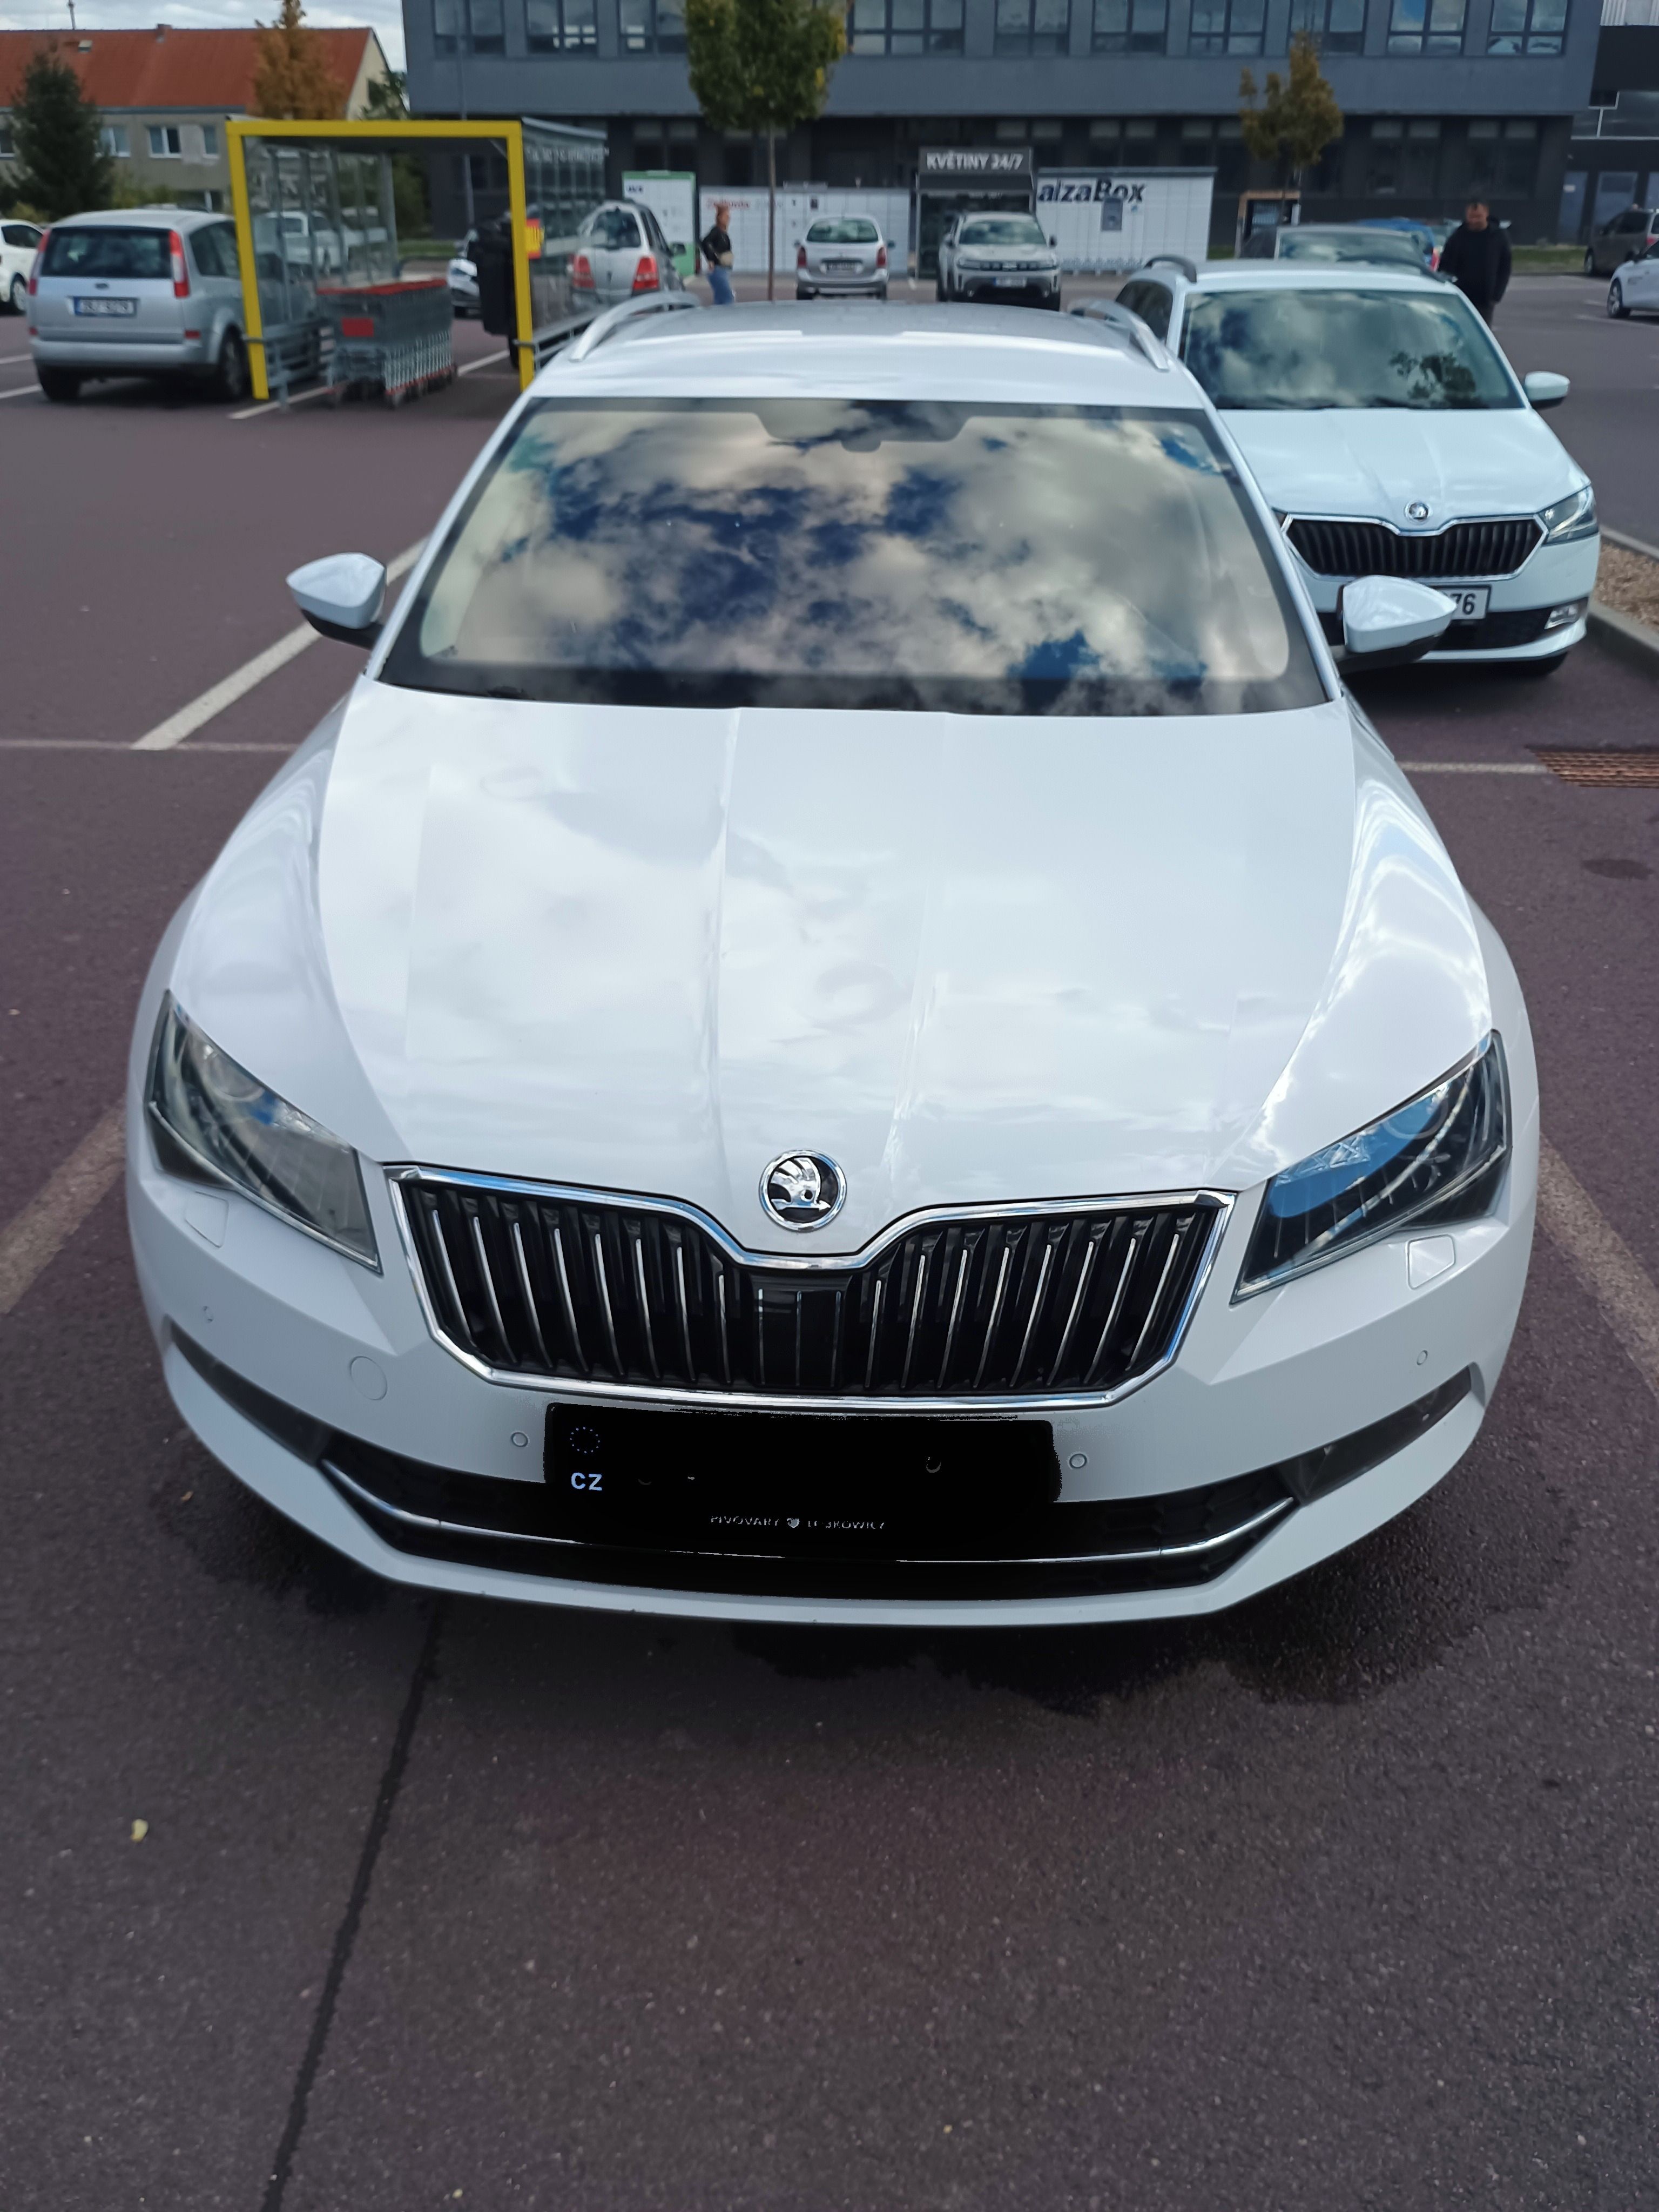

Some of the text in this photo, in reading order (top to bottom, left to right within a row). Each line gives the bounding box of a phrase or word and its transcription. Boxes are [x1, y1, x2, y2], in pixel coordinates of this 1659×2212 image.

[991, 153, 1023, 171] 24/7
[1448, 593, 1476, 615] 76
[571, 1472, 603, 1491] CZ
